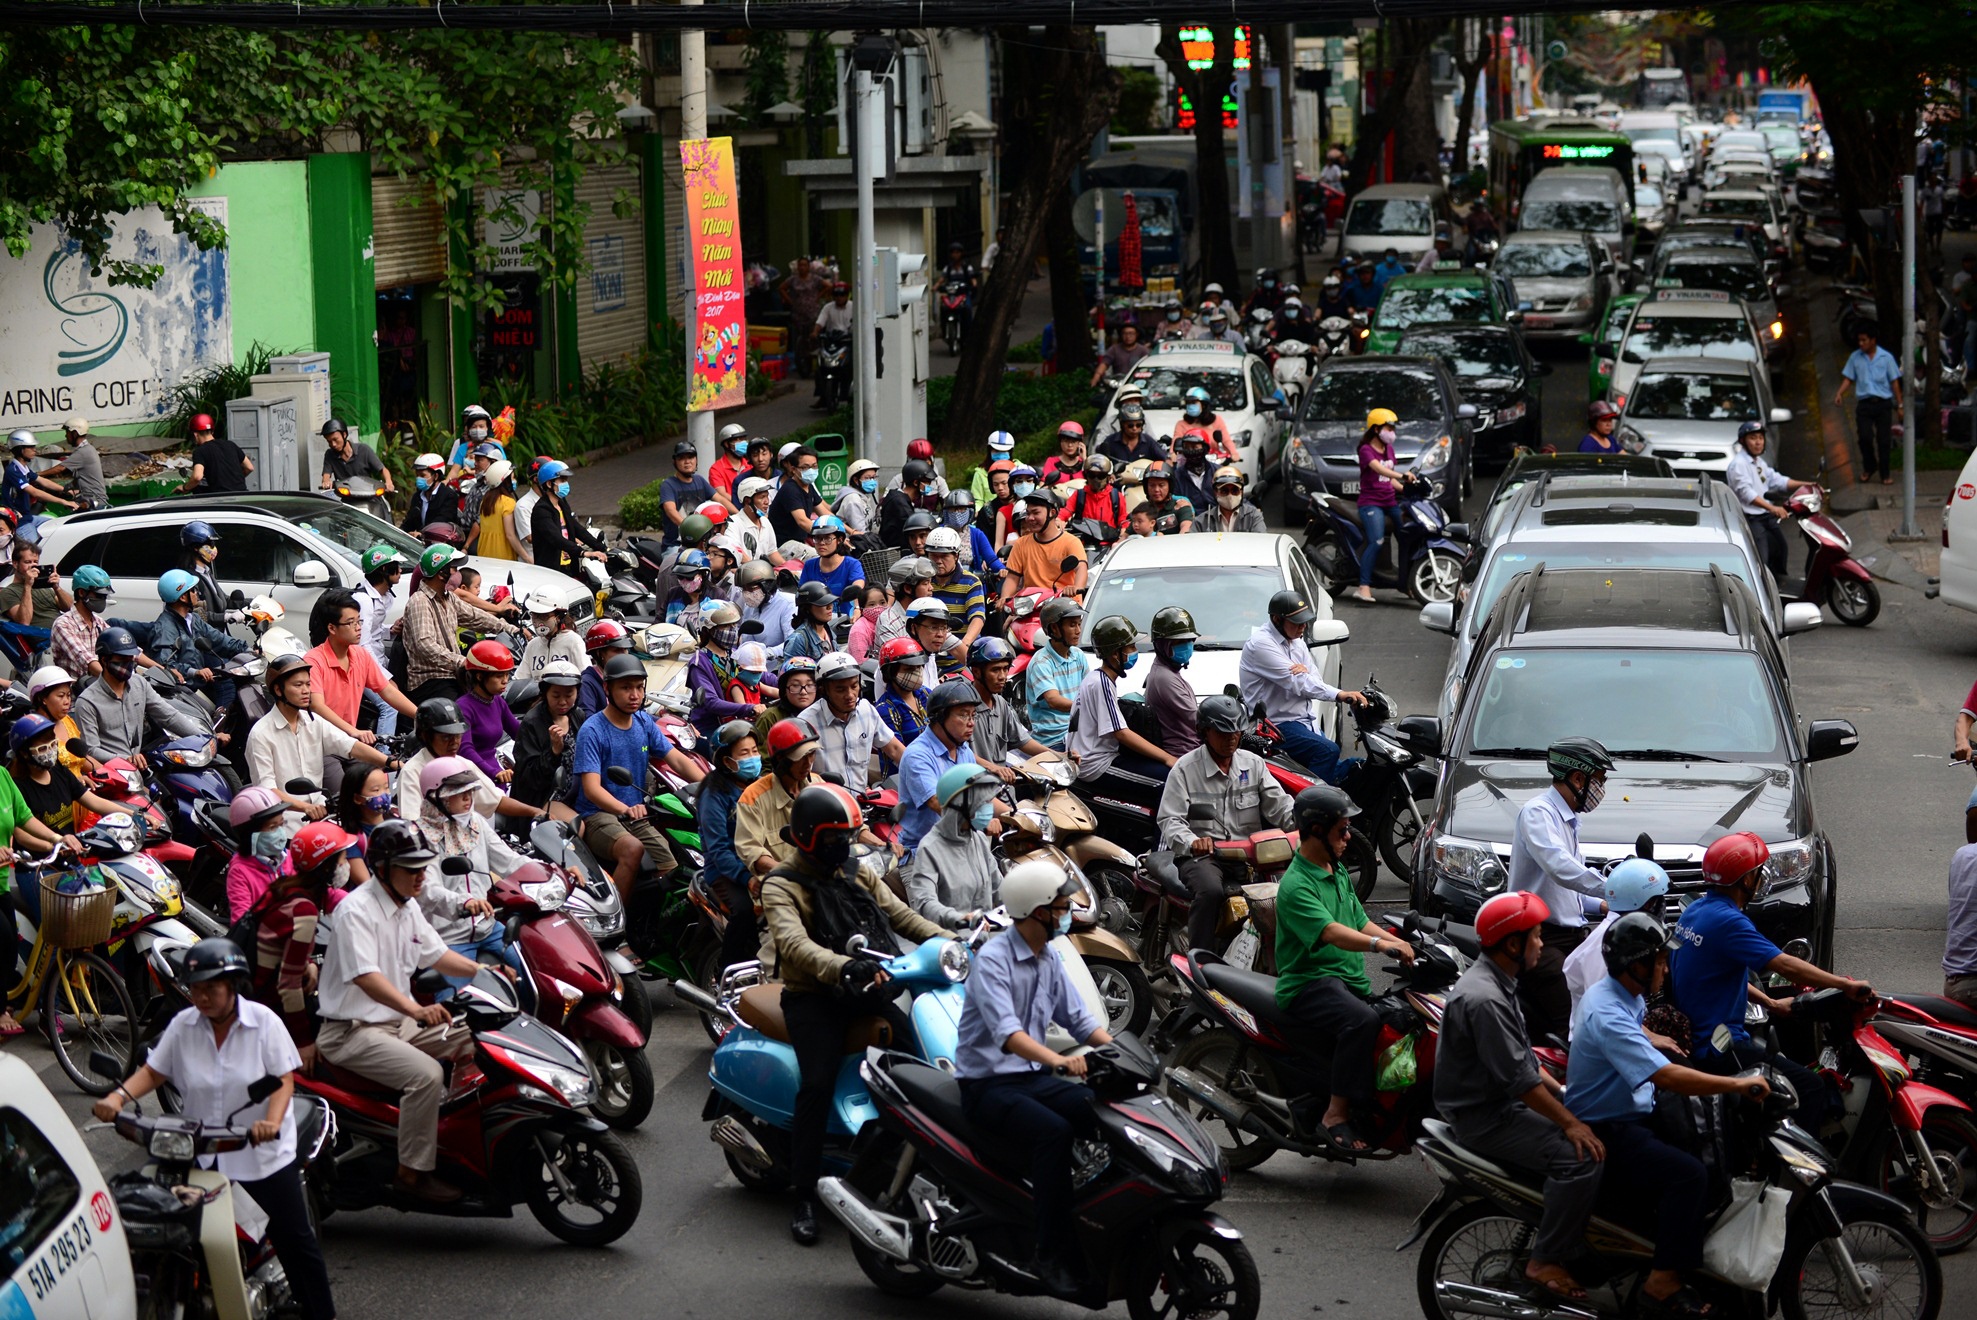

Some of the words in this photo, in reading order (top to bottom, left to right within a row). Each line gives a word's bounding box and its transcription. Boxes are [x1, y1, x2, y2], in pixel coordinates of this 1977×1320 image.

[702, 191, 729, 210] Chúc
[702, 244, 732, 262] Năm
[704, 268, 734, 288] Mới
[705, 305, 725, 317] 2017
[28, 1255, 57, 1301] 51A
[51, 1229, 79, 1277] 295
[72, 1215, 92, 1252] 23
